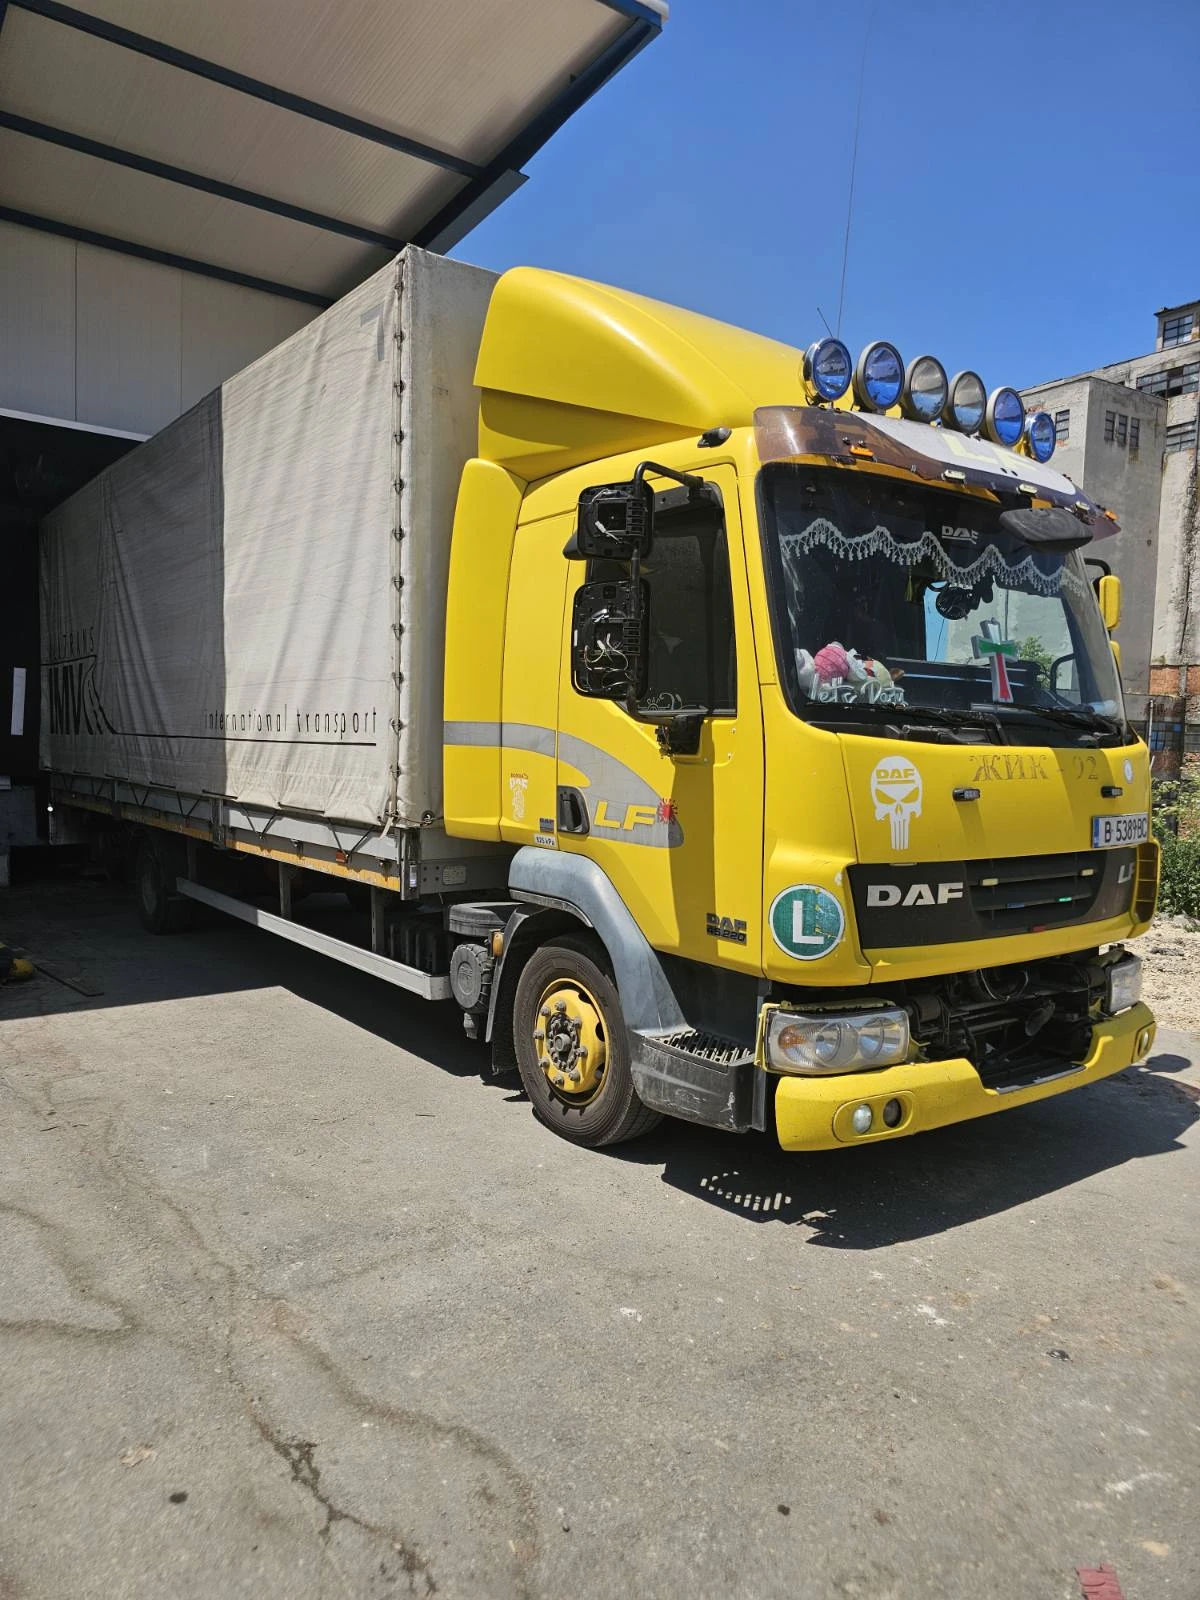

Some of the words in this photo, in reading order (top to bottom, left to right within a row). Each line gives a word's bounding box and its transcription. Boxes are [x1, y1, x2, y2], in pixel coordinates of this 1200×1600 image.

[941, 525, 979, 540] DAF
[204, 704, 287, 732] international
[296, 706, 377, 740] transport
[875, 767, 915, 780] DAF
[593, 799, 658, 831] LF
[1104, 821, 1112, 843] B
[867, 882, 963, 907] DAF
[706, 912, 747, 932] DAF
[792, 900, 825, 945] L
